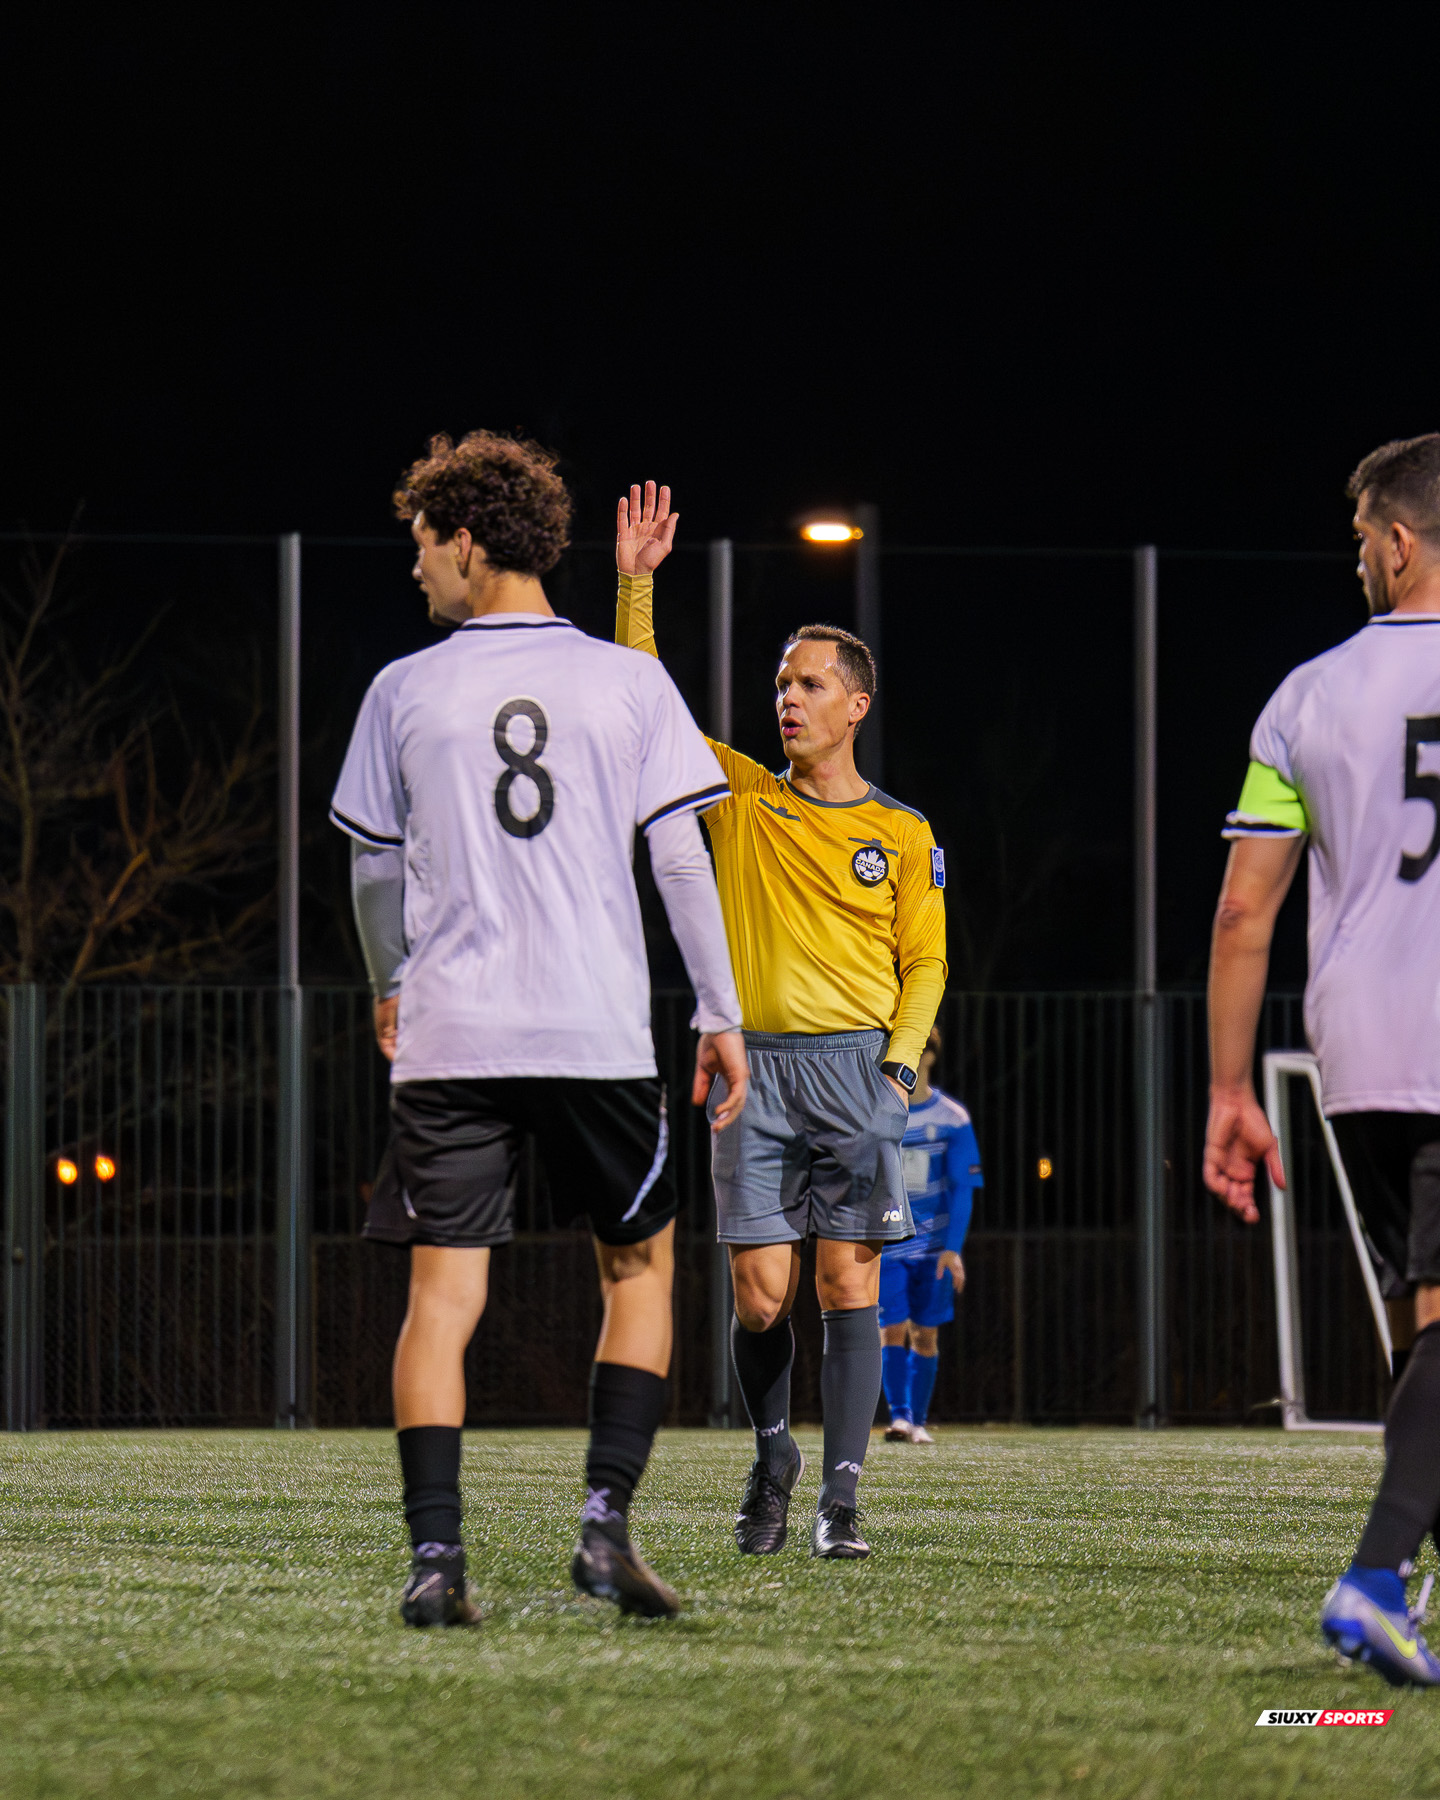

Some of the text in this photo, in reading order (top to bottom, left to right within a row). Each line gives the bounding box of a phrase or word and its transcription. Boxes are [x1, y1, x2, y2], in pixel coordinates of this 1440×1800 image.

[494, 699, 554, 838] 8
[1397, 716, 1440, 883] 5
[855, 858, 885, 875] CANADA
